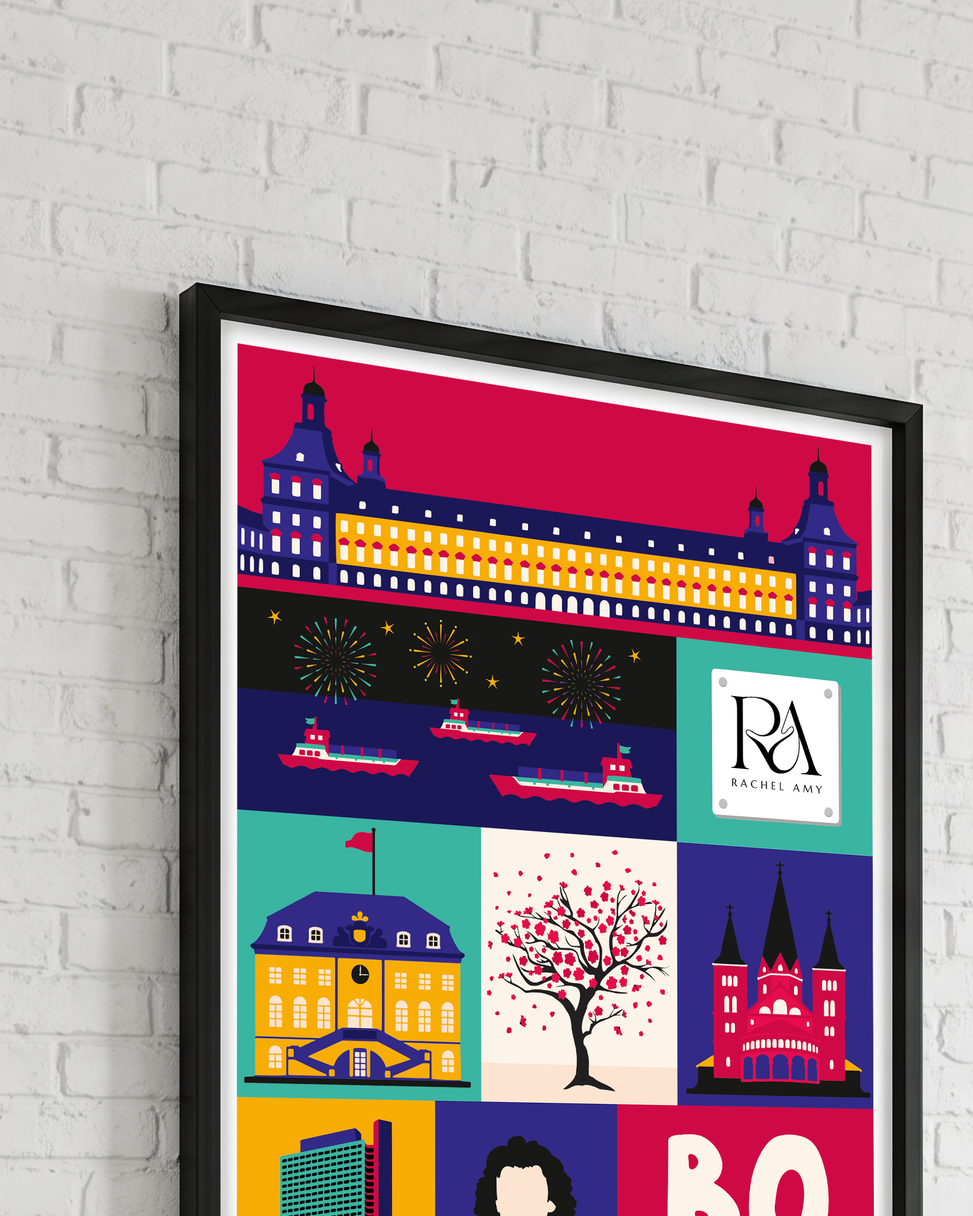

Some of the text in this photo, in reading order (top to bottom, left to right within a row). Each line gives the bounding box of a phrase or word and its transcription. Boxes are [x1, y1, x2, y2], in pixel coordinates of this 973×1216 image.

[730, 695, 823, 777] RA
[731, 777, 823, 794] RACHEL AMY
